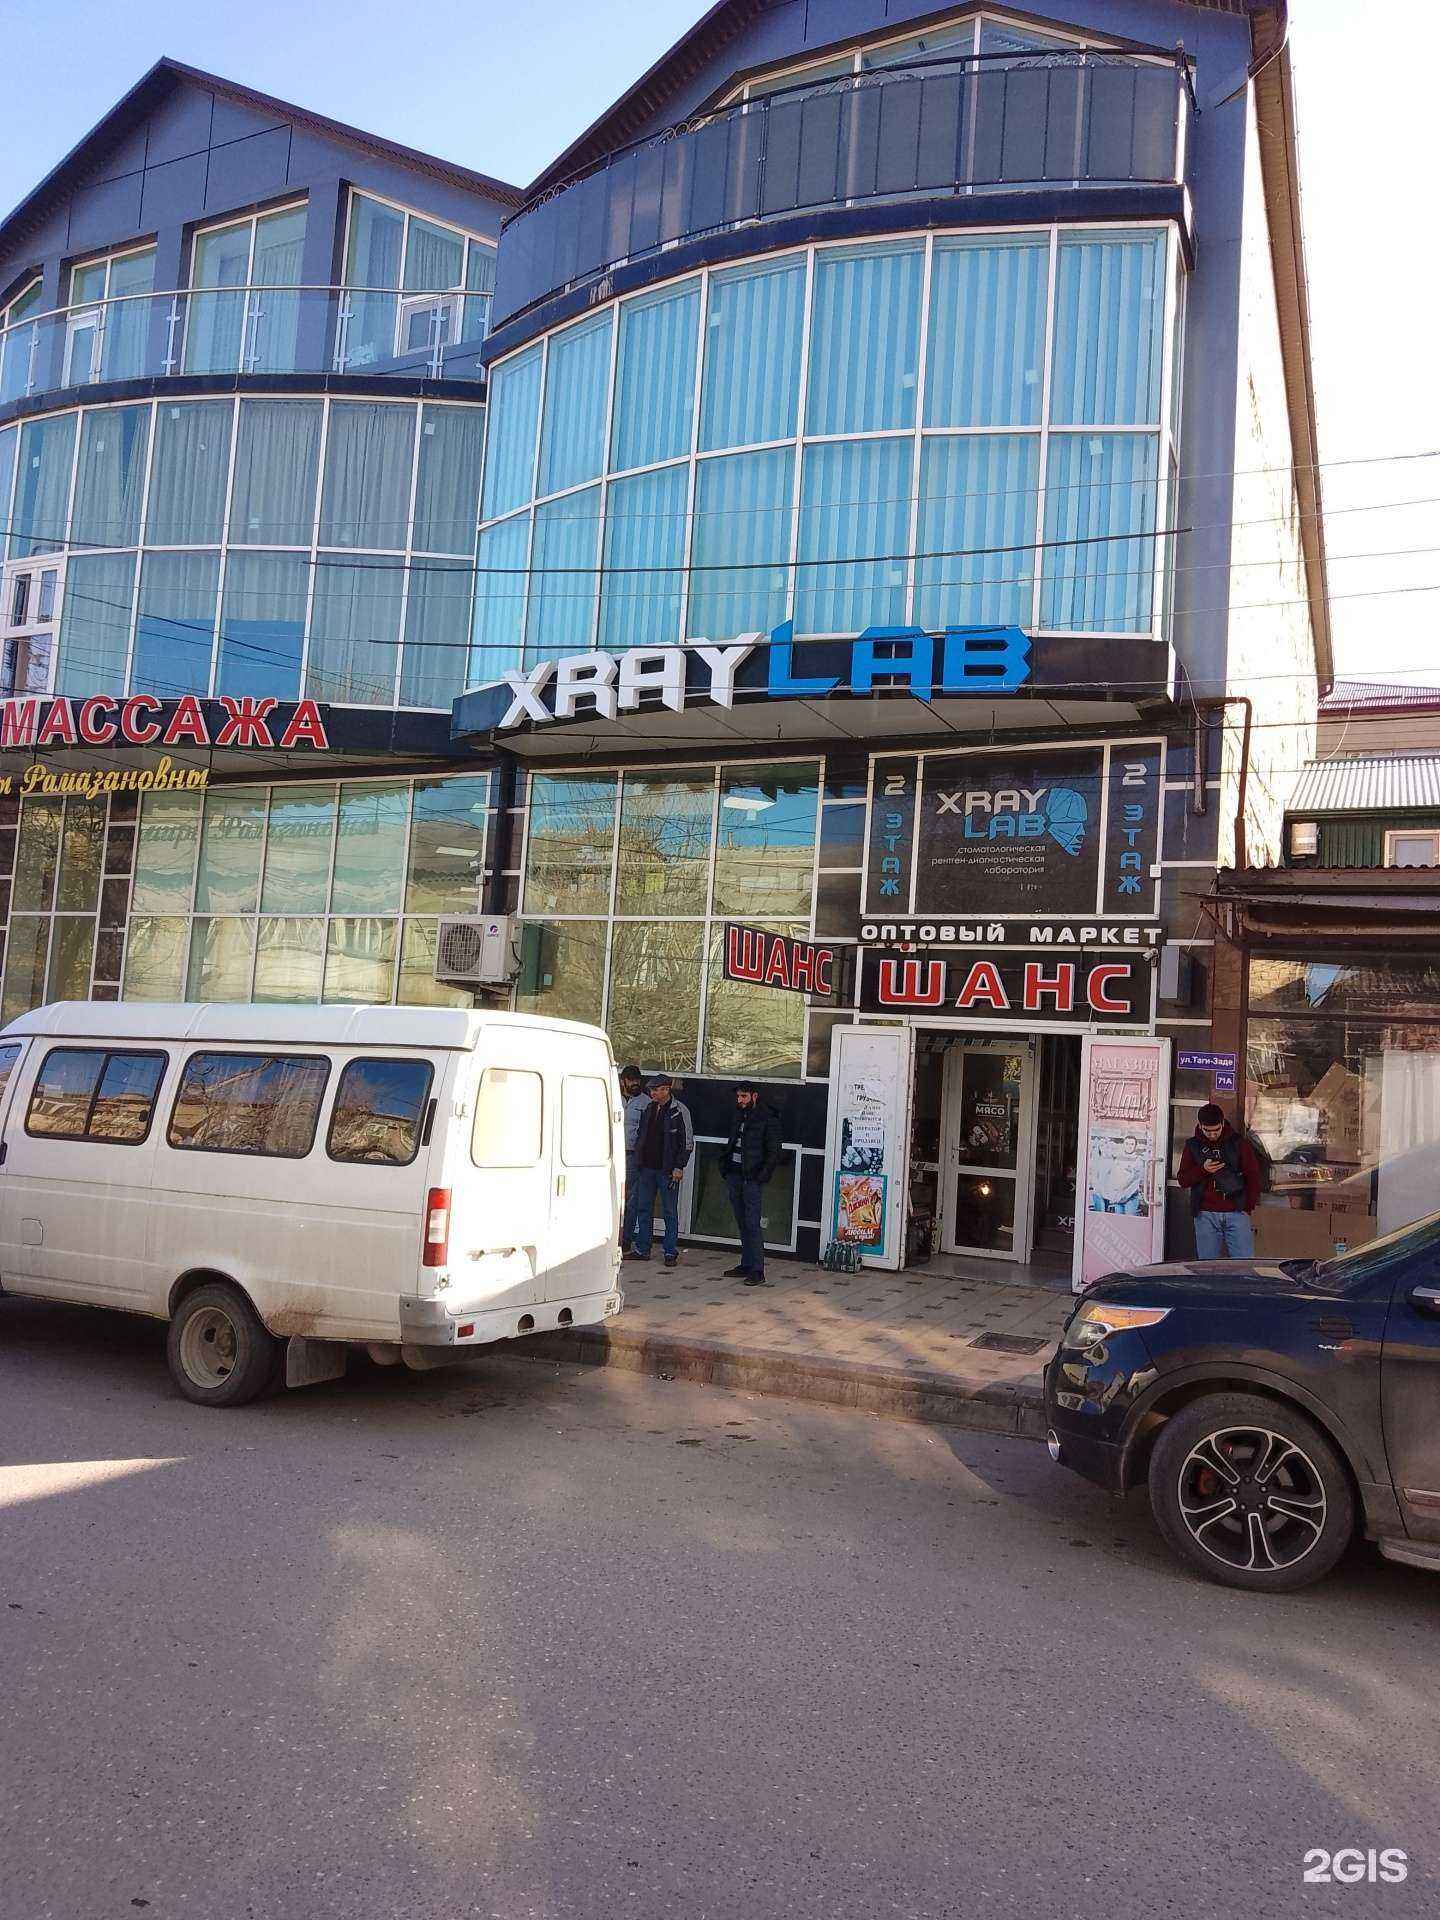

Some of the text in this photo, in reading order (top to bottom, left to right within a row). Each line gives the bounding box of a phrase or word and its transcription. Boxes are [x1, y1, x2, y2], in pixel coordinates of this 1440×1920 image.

[498, 619, 1032, 728] XRAY LAB
[0, 694, 329, 749] МАССАЖА
[19, 755, 210, 800] Рамазановны
[936, 788, 1047, 816] XRAY
[879, 776, 906, 896] 2 ЭТАЖ
[963, 813, 1047, 840] LAB
[1117, 763, 1148, 895] 2 ЭТАЖ
[931, 855, 1045, 866] рентген-диагностическая
[957, 845, 1046, 855] стоматологическая
[984, 866, 1045, 875] лаборатория
[861, 922, 1162, 944] ОПТОВЫЙ МАРКЕТ
[728, 926, 833, 995] ШАНС
[879, 959, 1131, 1013] ШАНС
[975, 1106, 1005, 1115] МЯСО
